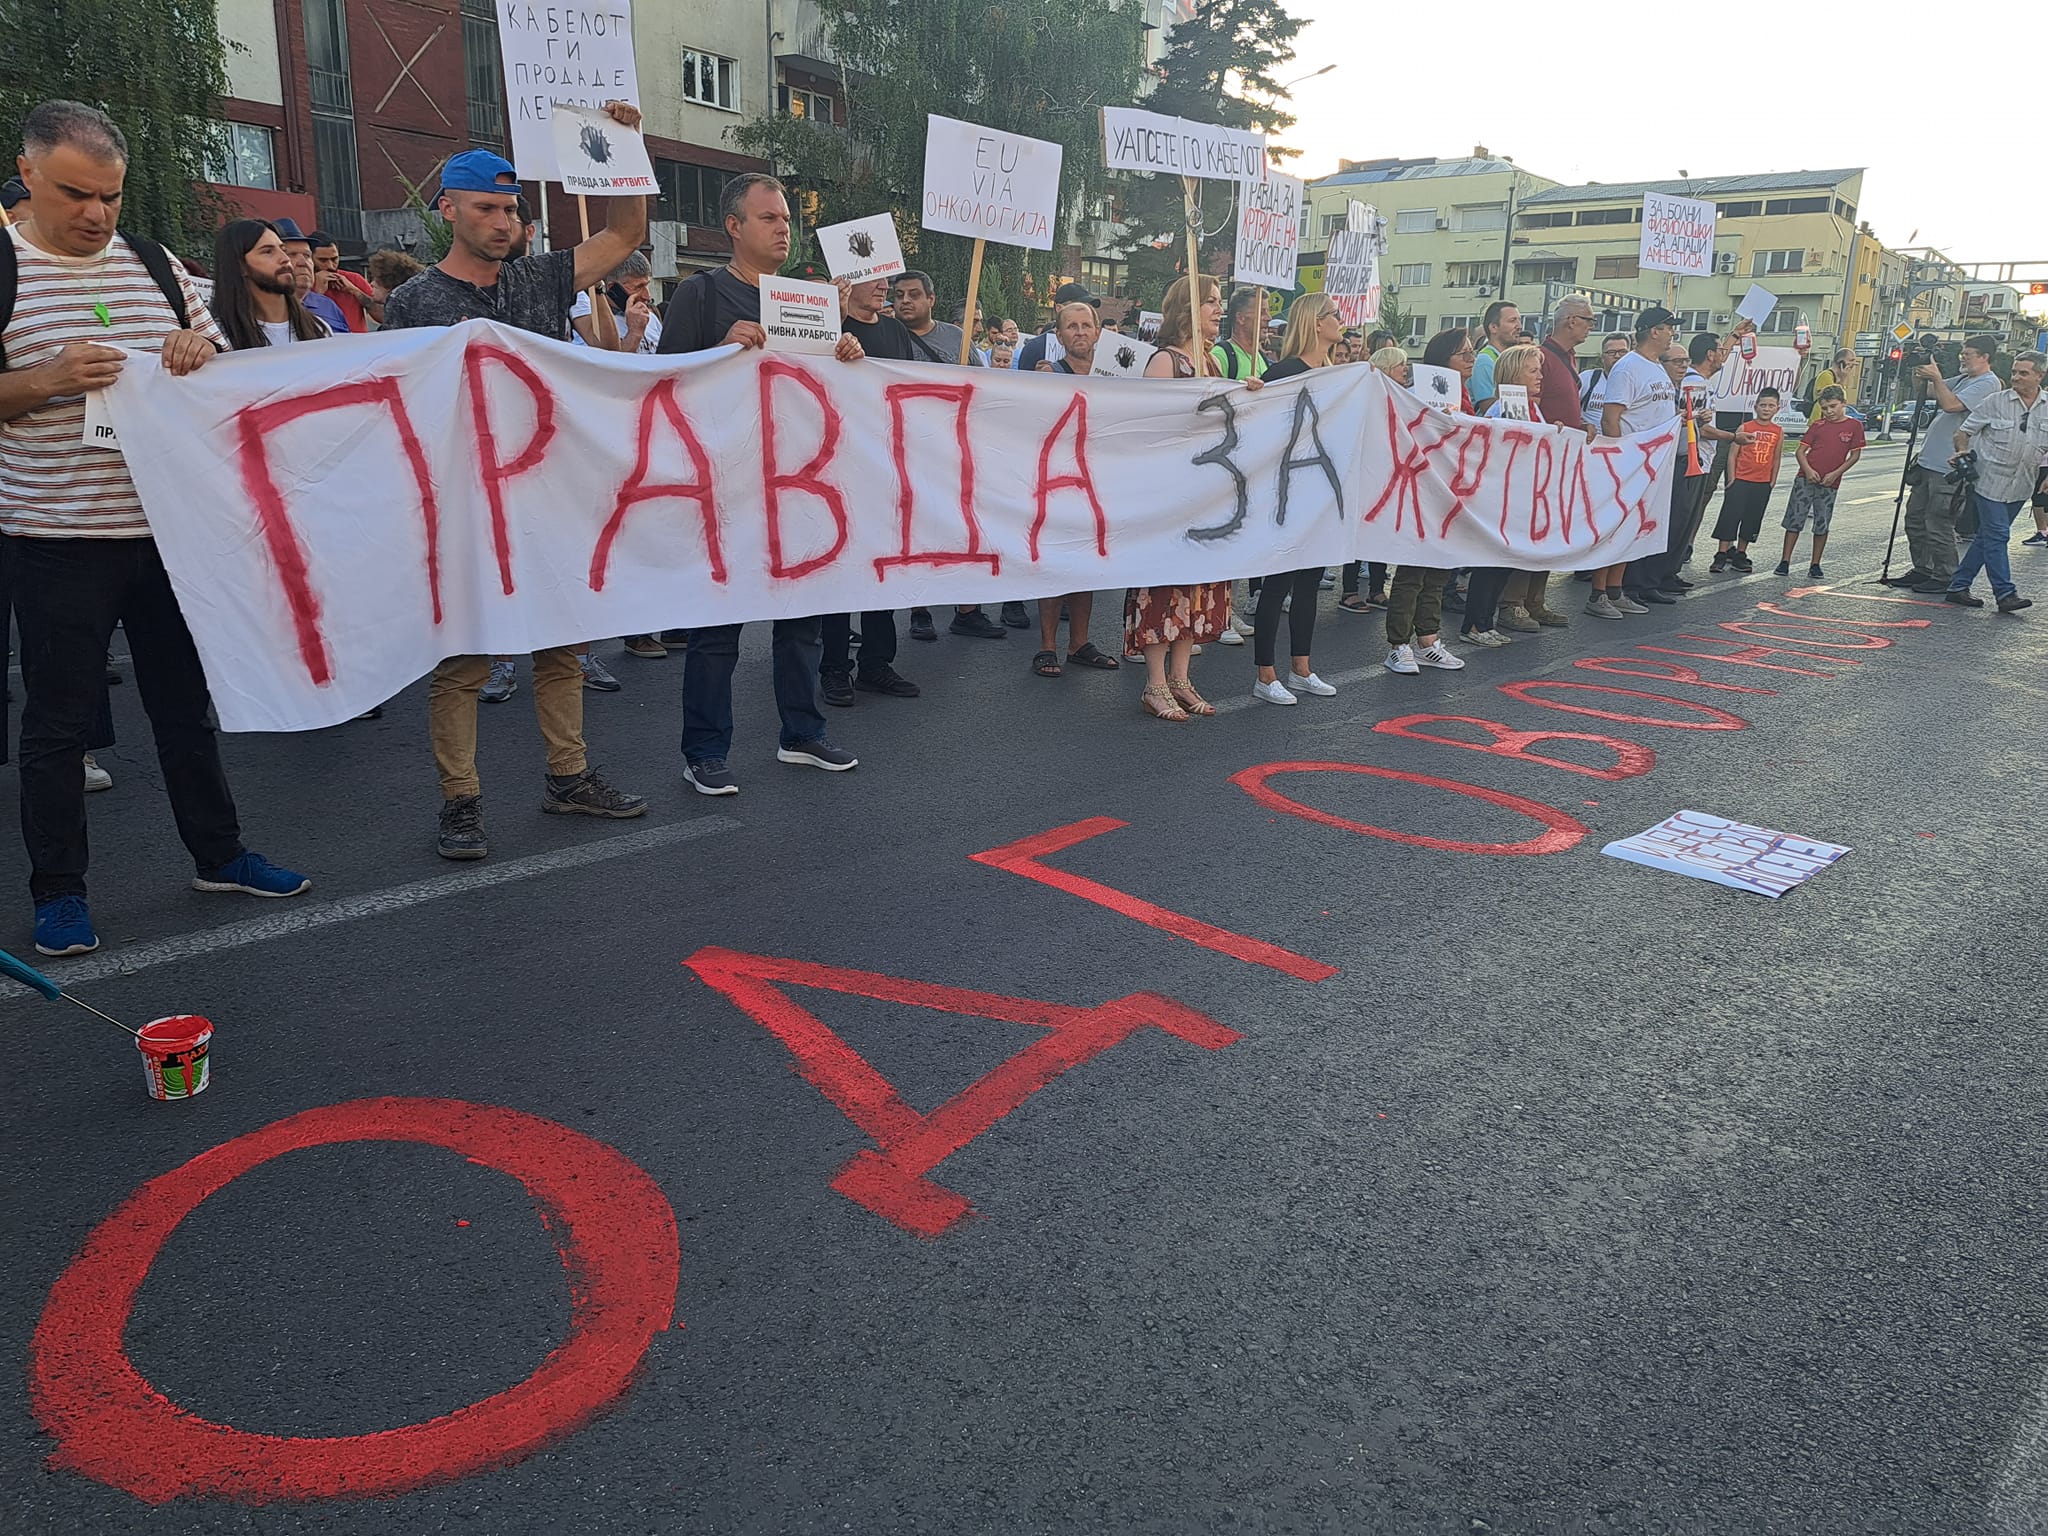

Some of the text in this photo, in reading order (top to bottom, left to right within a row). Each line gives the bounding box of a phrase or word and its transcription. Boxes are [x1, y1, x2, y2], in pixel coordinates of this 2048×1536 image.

[507, 1, 625, 37] КАБЕЛОТ
[547, 38, 580, 62] ГИ
[515, 63, 625, 88] ПРОДАДЕ
[975, 136, 1020, 174] EU
[1113, 126, 1178, 168] УАПСЕТЕ
[1182, 135, 1202, 170] ГО
[567, 175, 652, 189] ПРАВДА ЗА ЖРТВИТЕ
[972, 171, 1013, 203] VIA
[1282, 184, 1295, 218] ЗА
[1649, 199, 1702, 223] ЗА БОЛНИ
[926, 191, 1048, 239] ОНКОЛОГИЈА
[1284, 216, 1297, 249] НА
[1653, 232, 1708, 255] ЗА АПАШИ
[1645, 246, 1704, 269] АМНЕСТИЈА
[841, 260, 901, 281] РАВДА ЗА ЖРТВИТЕ
[770, 289, 830, 308] НАШИОТ МОЛК
[767, 324, 838, 343] НИВНА ХРАБРОСТ
[238, 341, 1674, 688] ПРАВДА ЗА ЖРТВИТЕ
